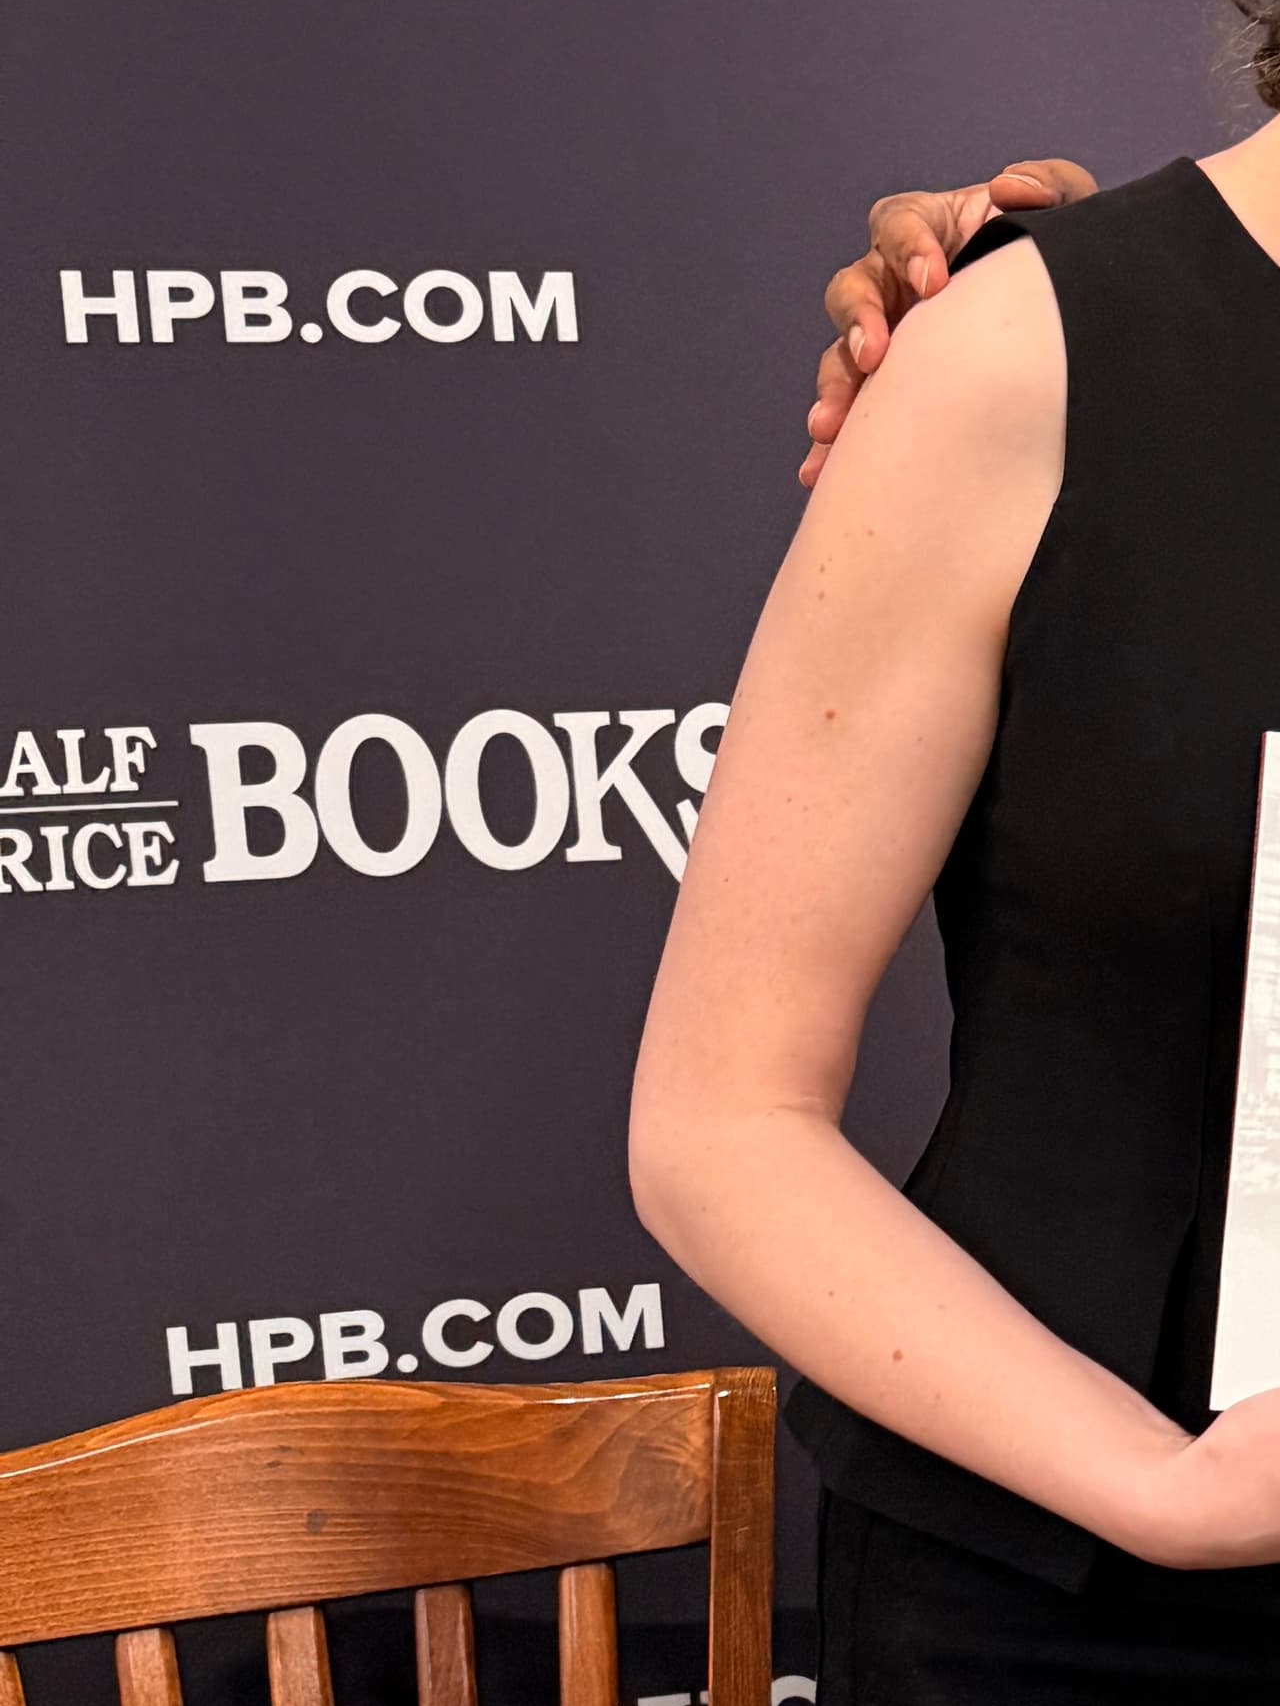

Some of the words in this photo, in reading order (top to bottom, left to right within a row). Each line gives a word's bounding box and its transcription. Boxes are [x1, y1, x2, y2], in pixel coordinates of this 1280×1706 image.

[60, 269, 579, 344] HPB.COM
[0, 726, 157, 797] ALF
[0, 821, 180, 893] RICE
[166, 1283, 665, 1396] HPB.COM
